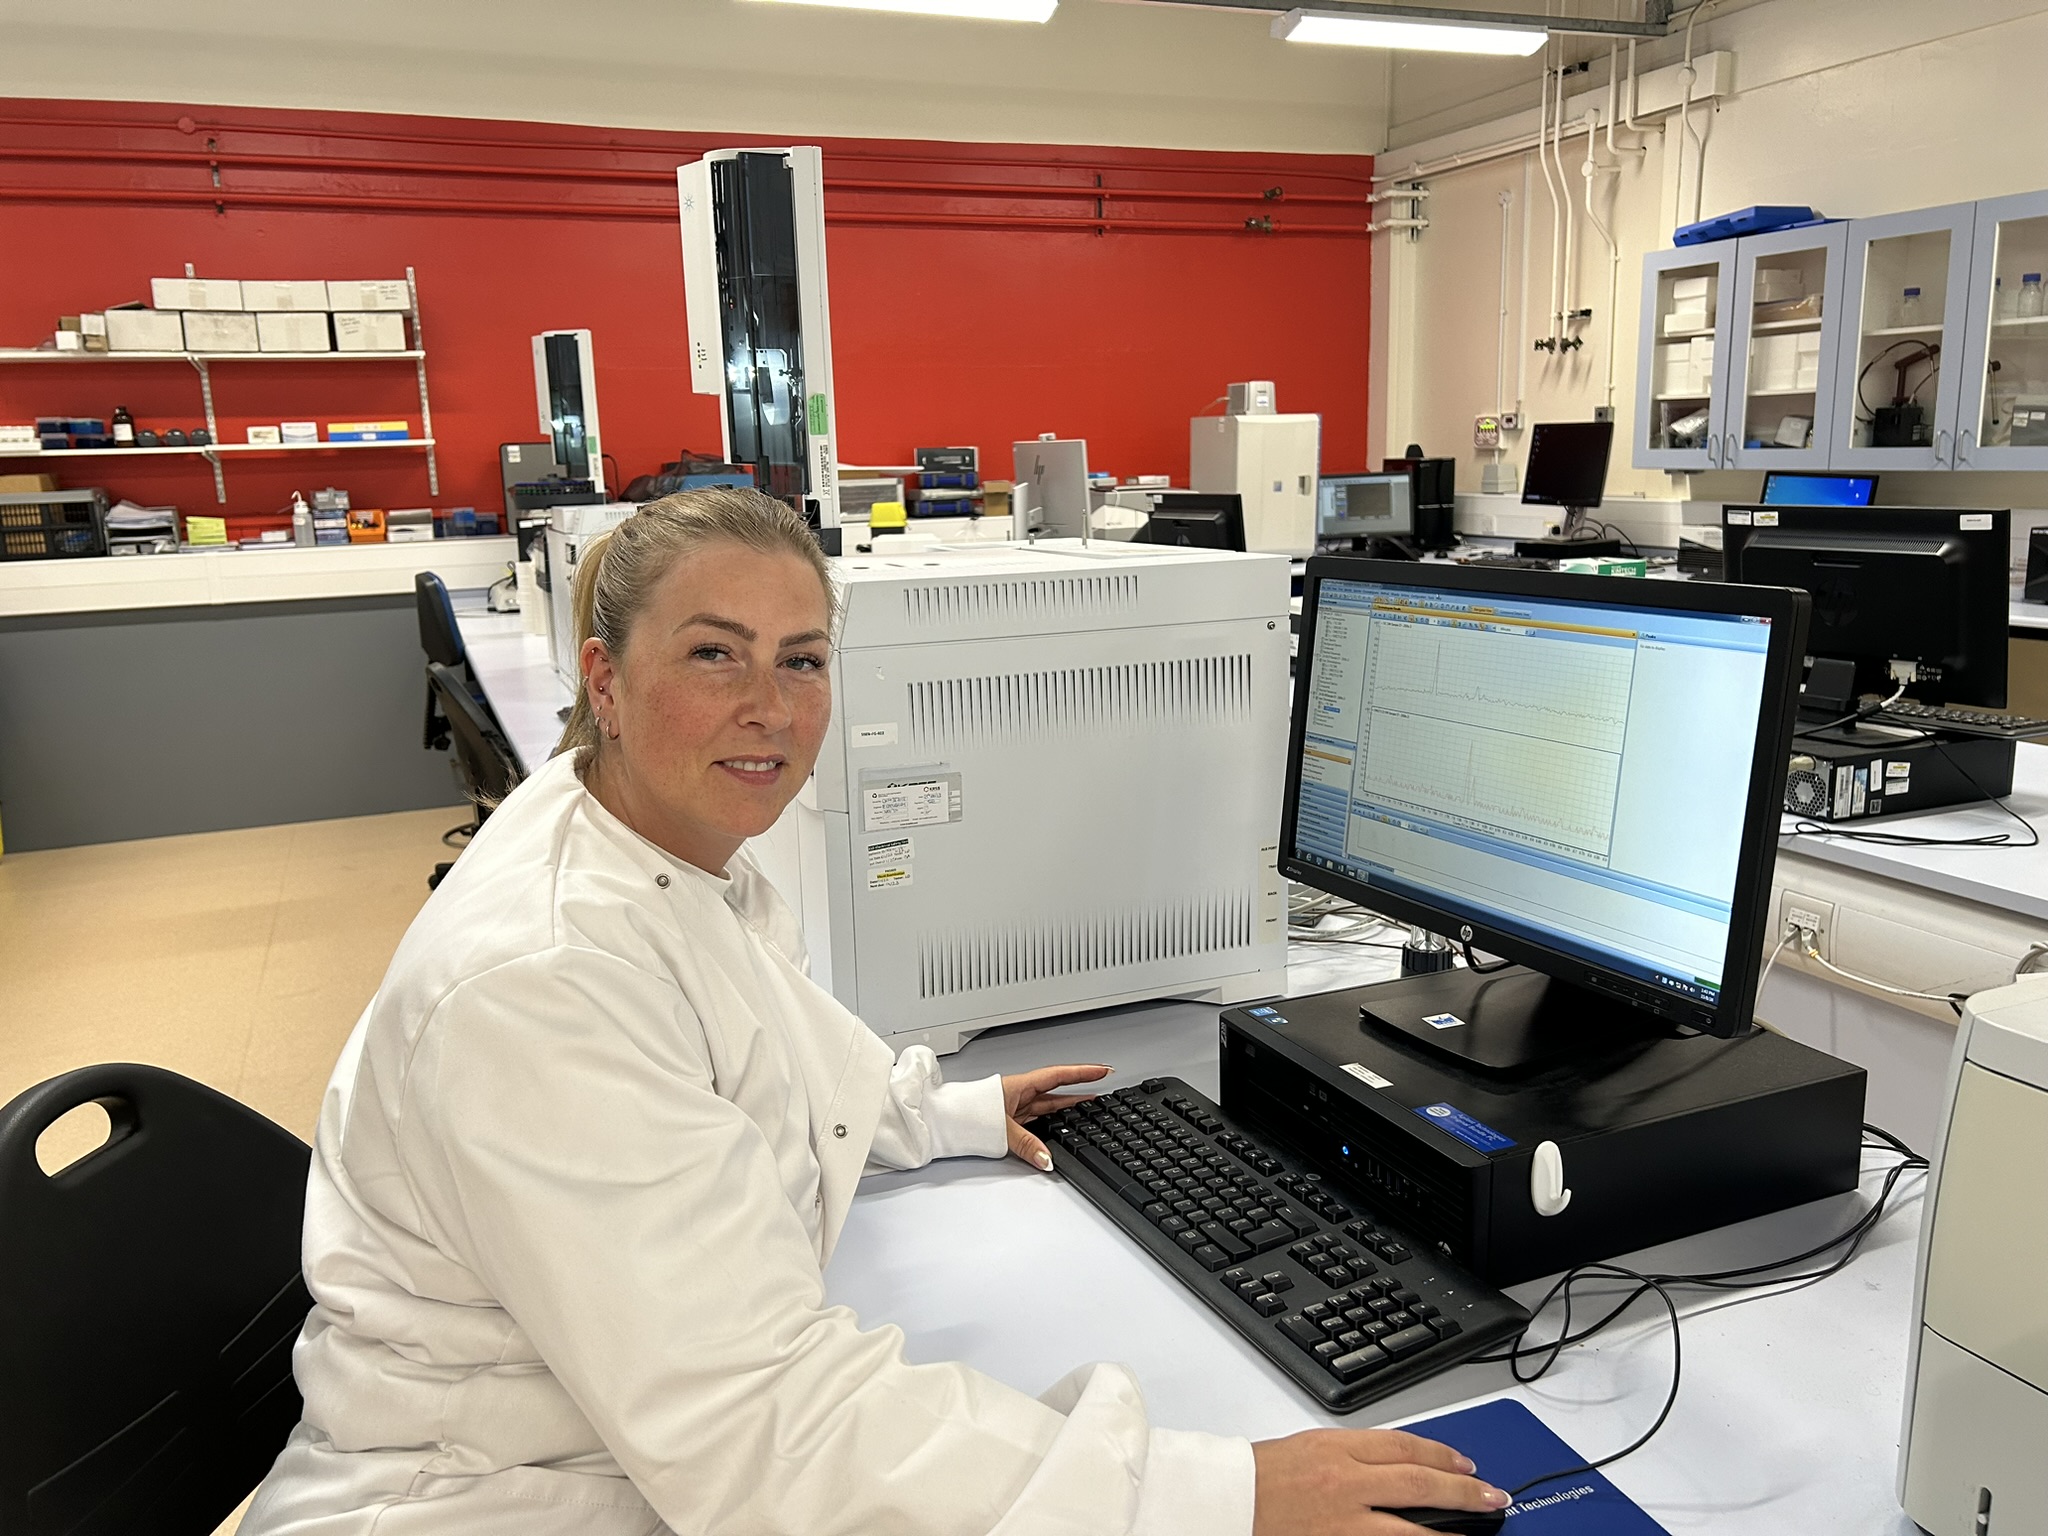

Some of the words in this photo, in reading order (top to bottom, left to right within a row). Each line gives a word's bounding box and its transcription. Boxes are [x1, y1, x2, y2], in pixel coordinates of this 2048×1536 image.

[1033, 455, 1045, 485] hp
[1461, 925, 1473, 941] hp
[1516, 1485, 1595, 1512] Technologies
